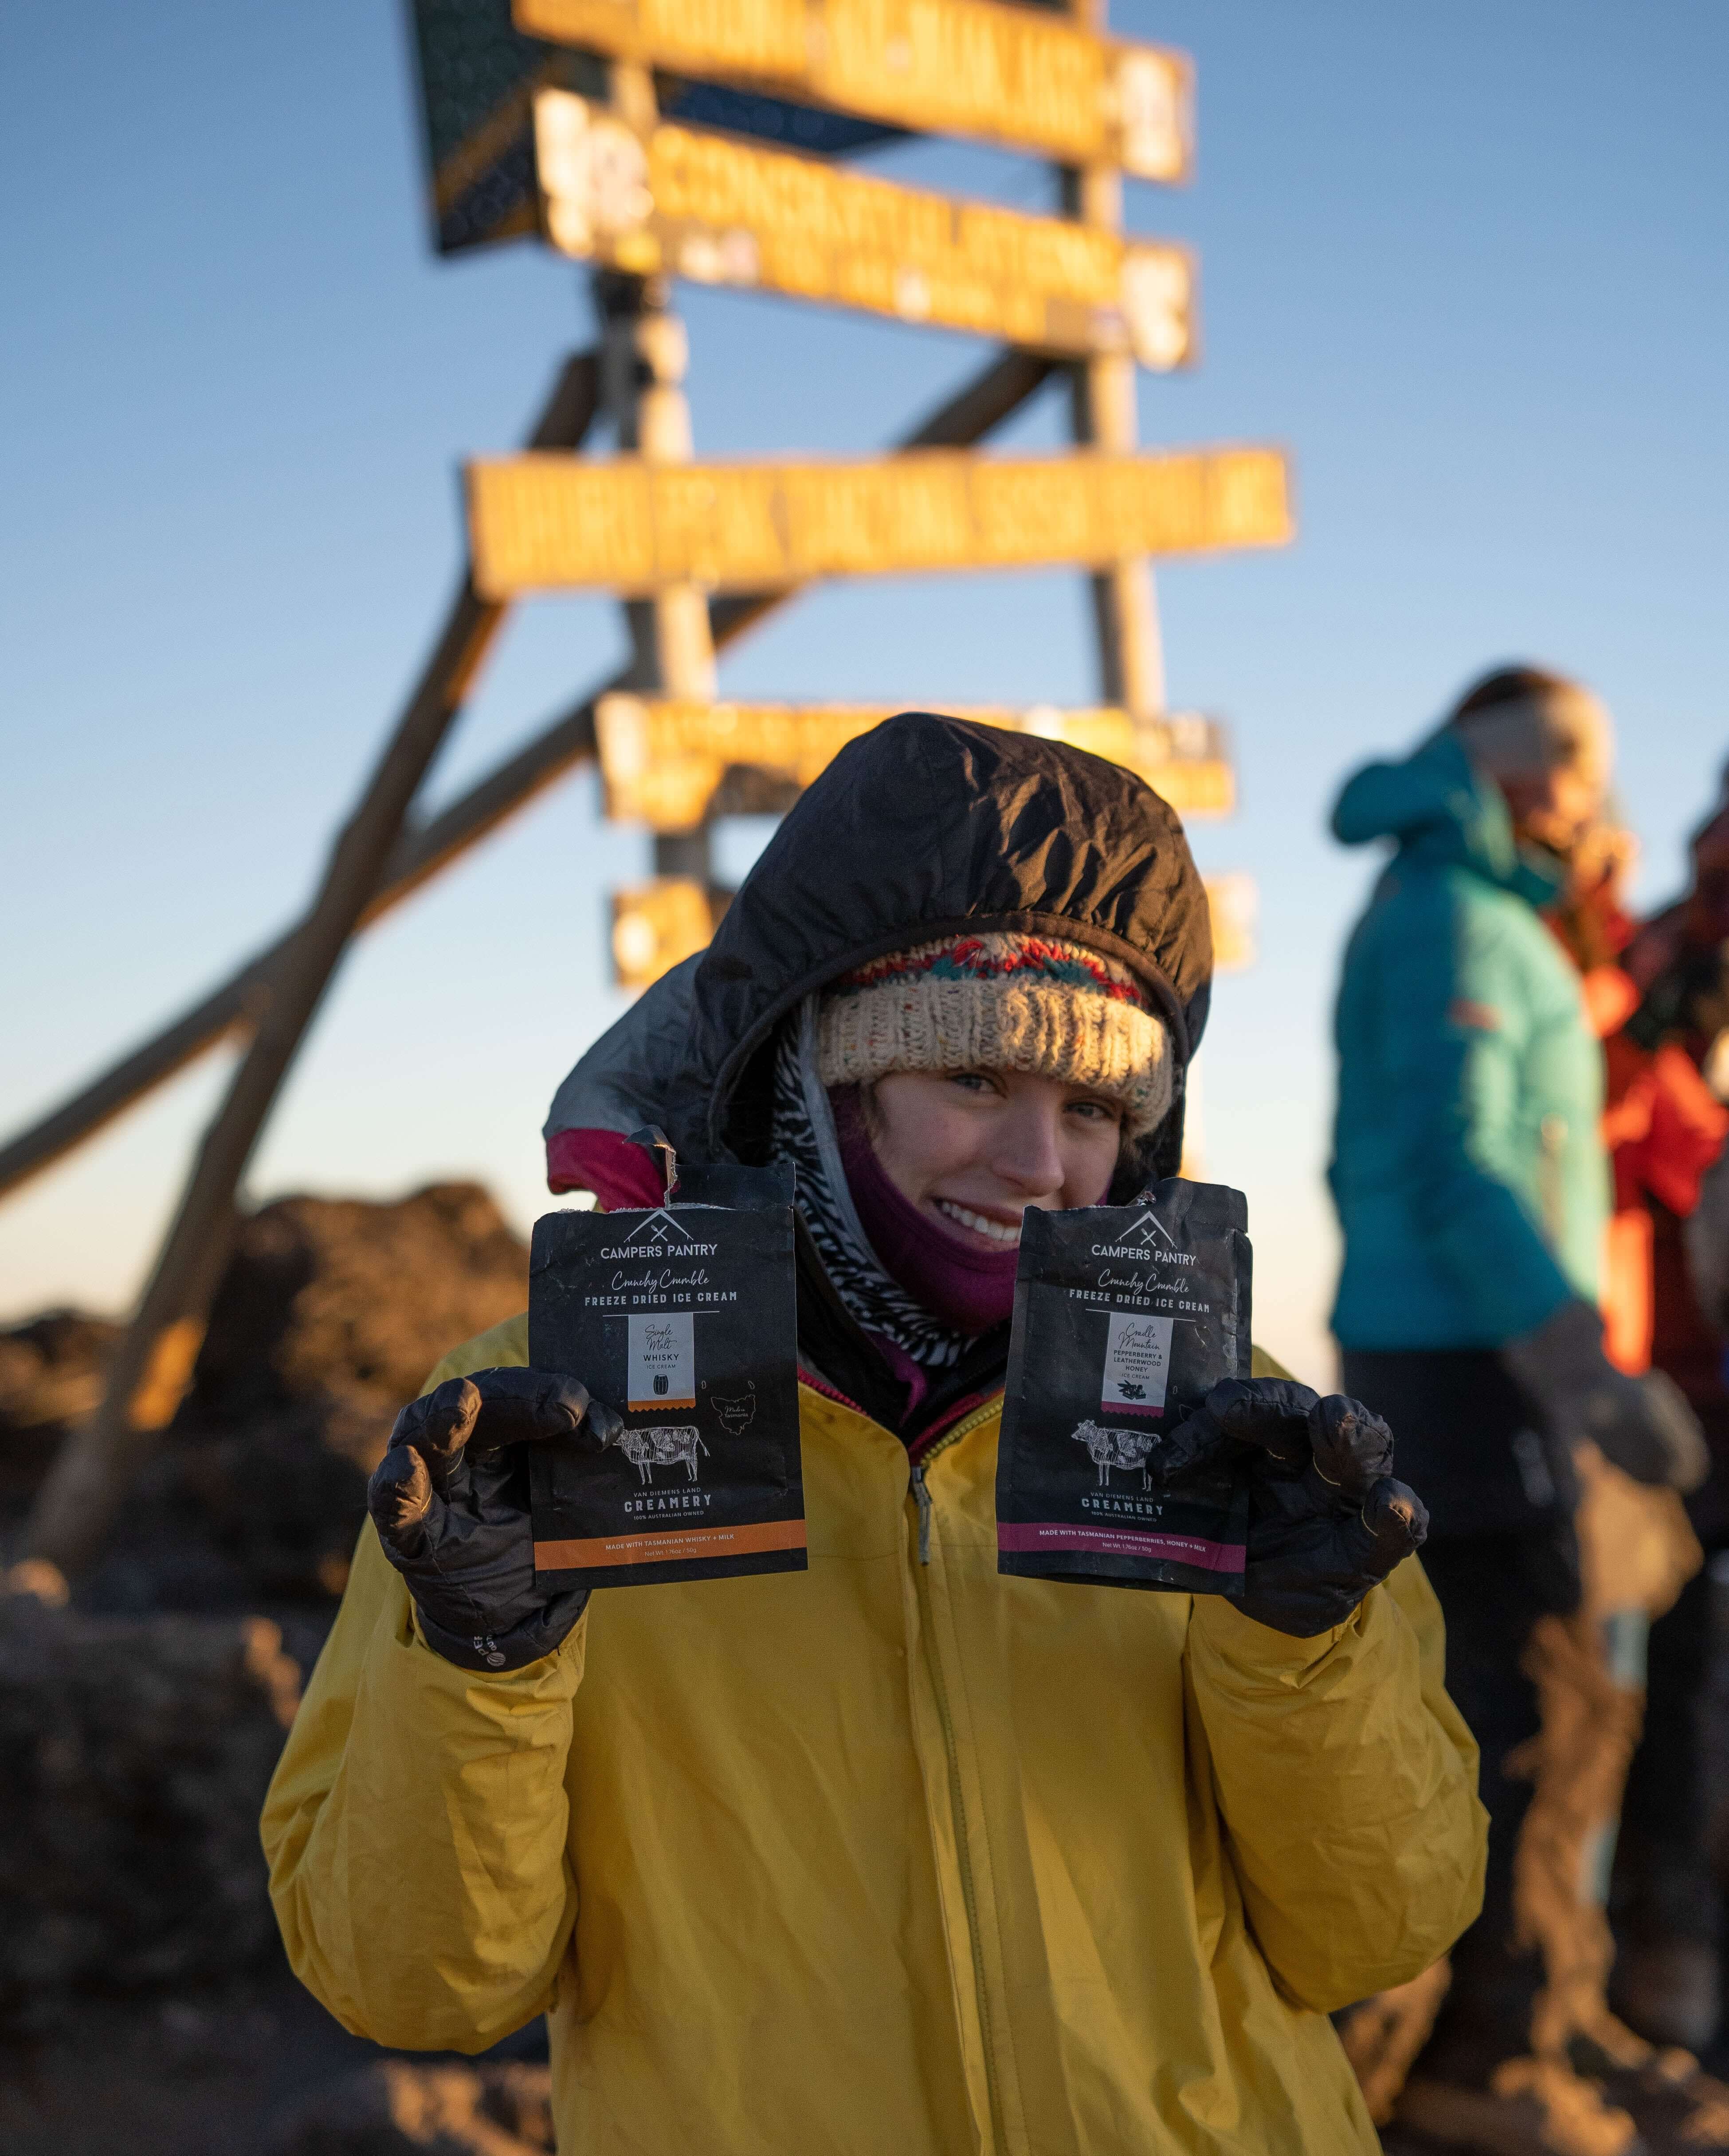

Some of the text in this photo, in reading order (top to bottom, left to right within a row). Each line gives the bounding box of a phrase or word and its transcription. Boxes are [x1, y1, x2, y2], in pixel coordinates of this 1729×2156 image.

[600, 1244, 717, 1259] CAMPERS PANTRY
[1092, 1245, 1196, 1266] CAMPERS PANTRY
[612, 1269, 710, 1294] Crunchy Crumble
[1098, 1269, 1190, 1295] Crunchy Crumble
[585, 1291, 737, 1306] FREEZE DRIED ICE CREAM
[1069, 1288, 1210, 1313] FREEZE DRIED ICE CREAM
[645, 1323, 673, 1341] Single
[1125, 1322, 1157, 1339] Cradle
[647, 1337, 677, 1351] Malt
[1118, 1332, 1161, 1350] Mountain
[1113, 1350, 1157, 1359] PEPPERBERRY
[1113, 1357, 1161, 1367] LEATHERWOOD
[624, 1494, 711, 1512] CREAMERY
[1082, 1498, 1163, 1516] CREAMERY
[644, 1538, 684, 1547] TASMANIAN
[1078, 1531, 1115, 1539] TASMANIAN
[1116, 1534, 1165, 1545] PEPPERBERRIES,
[1194, 1544, 1206, 1552] MILK
